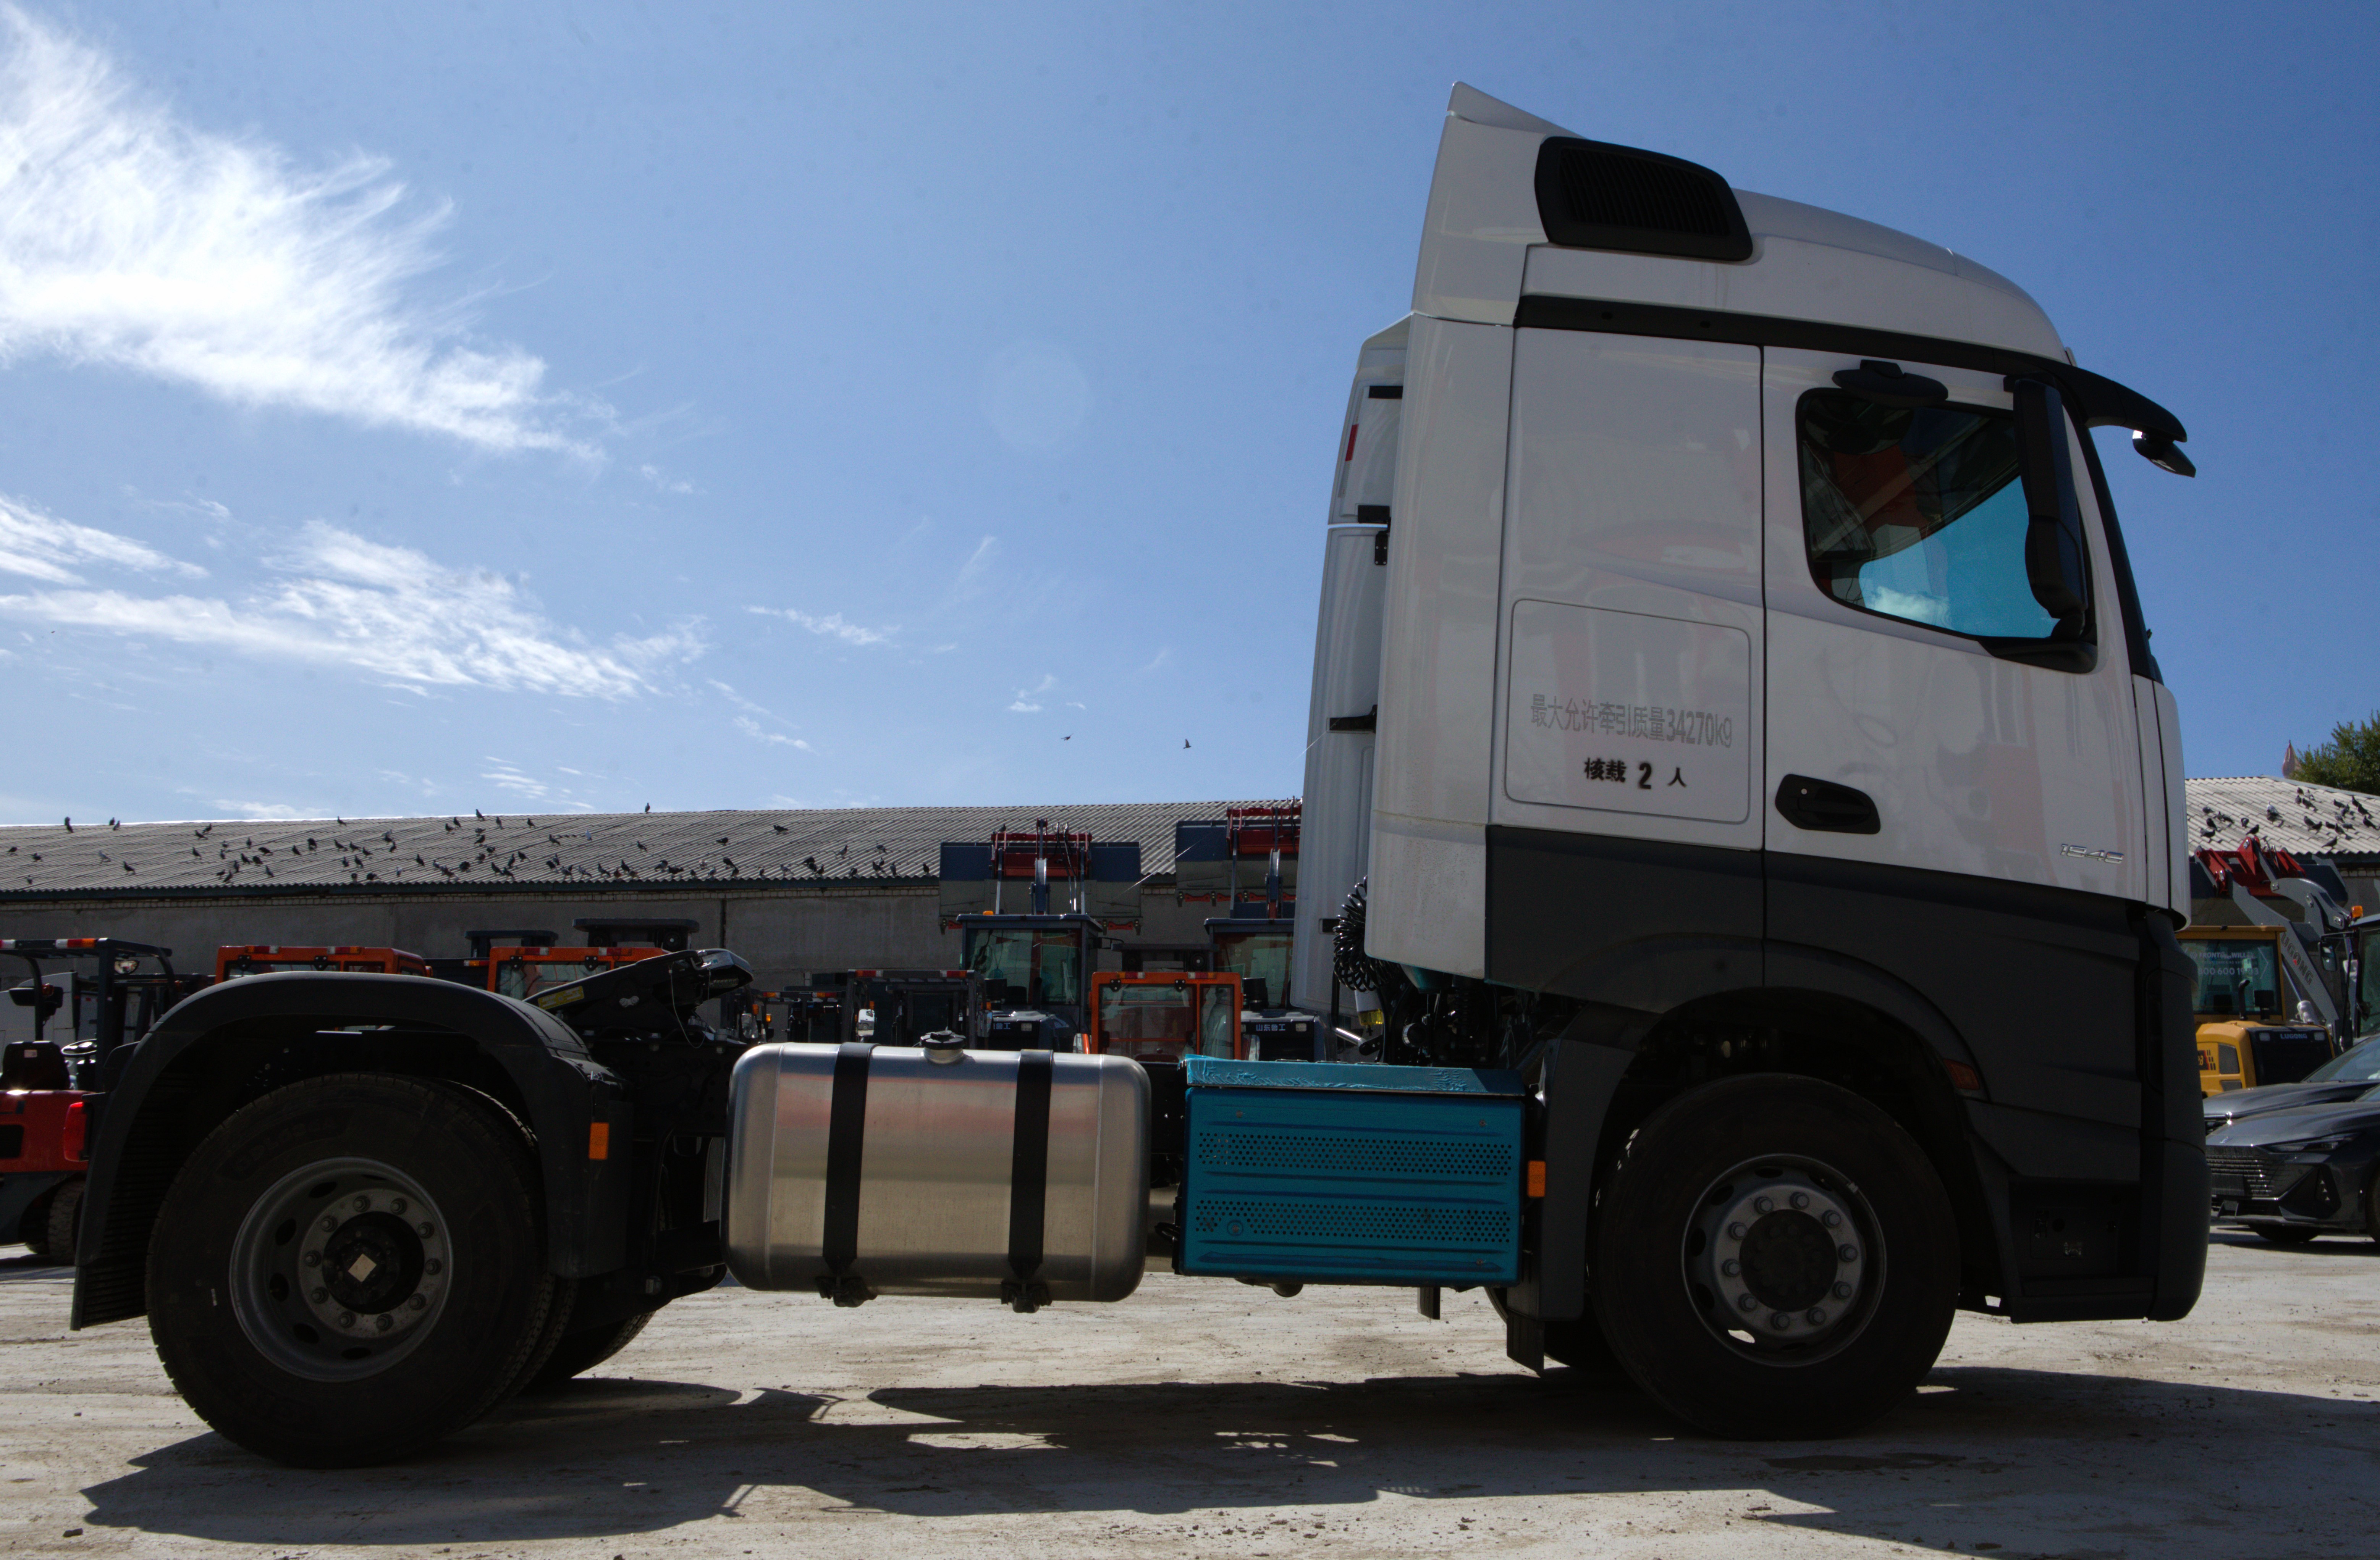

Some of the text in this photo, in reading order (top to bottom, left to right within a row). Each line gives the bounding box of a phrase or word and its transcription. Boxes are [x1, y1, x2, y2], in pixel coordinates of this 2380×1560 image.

[1530, 693, 1732, 748] 最大允许牵引质量34270kg
[1584, 757, 1687, 789] 核载 2 人
[2060, 843, 2124, 864] 1848
[2281, 932, 2314, 985] UGONG
